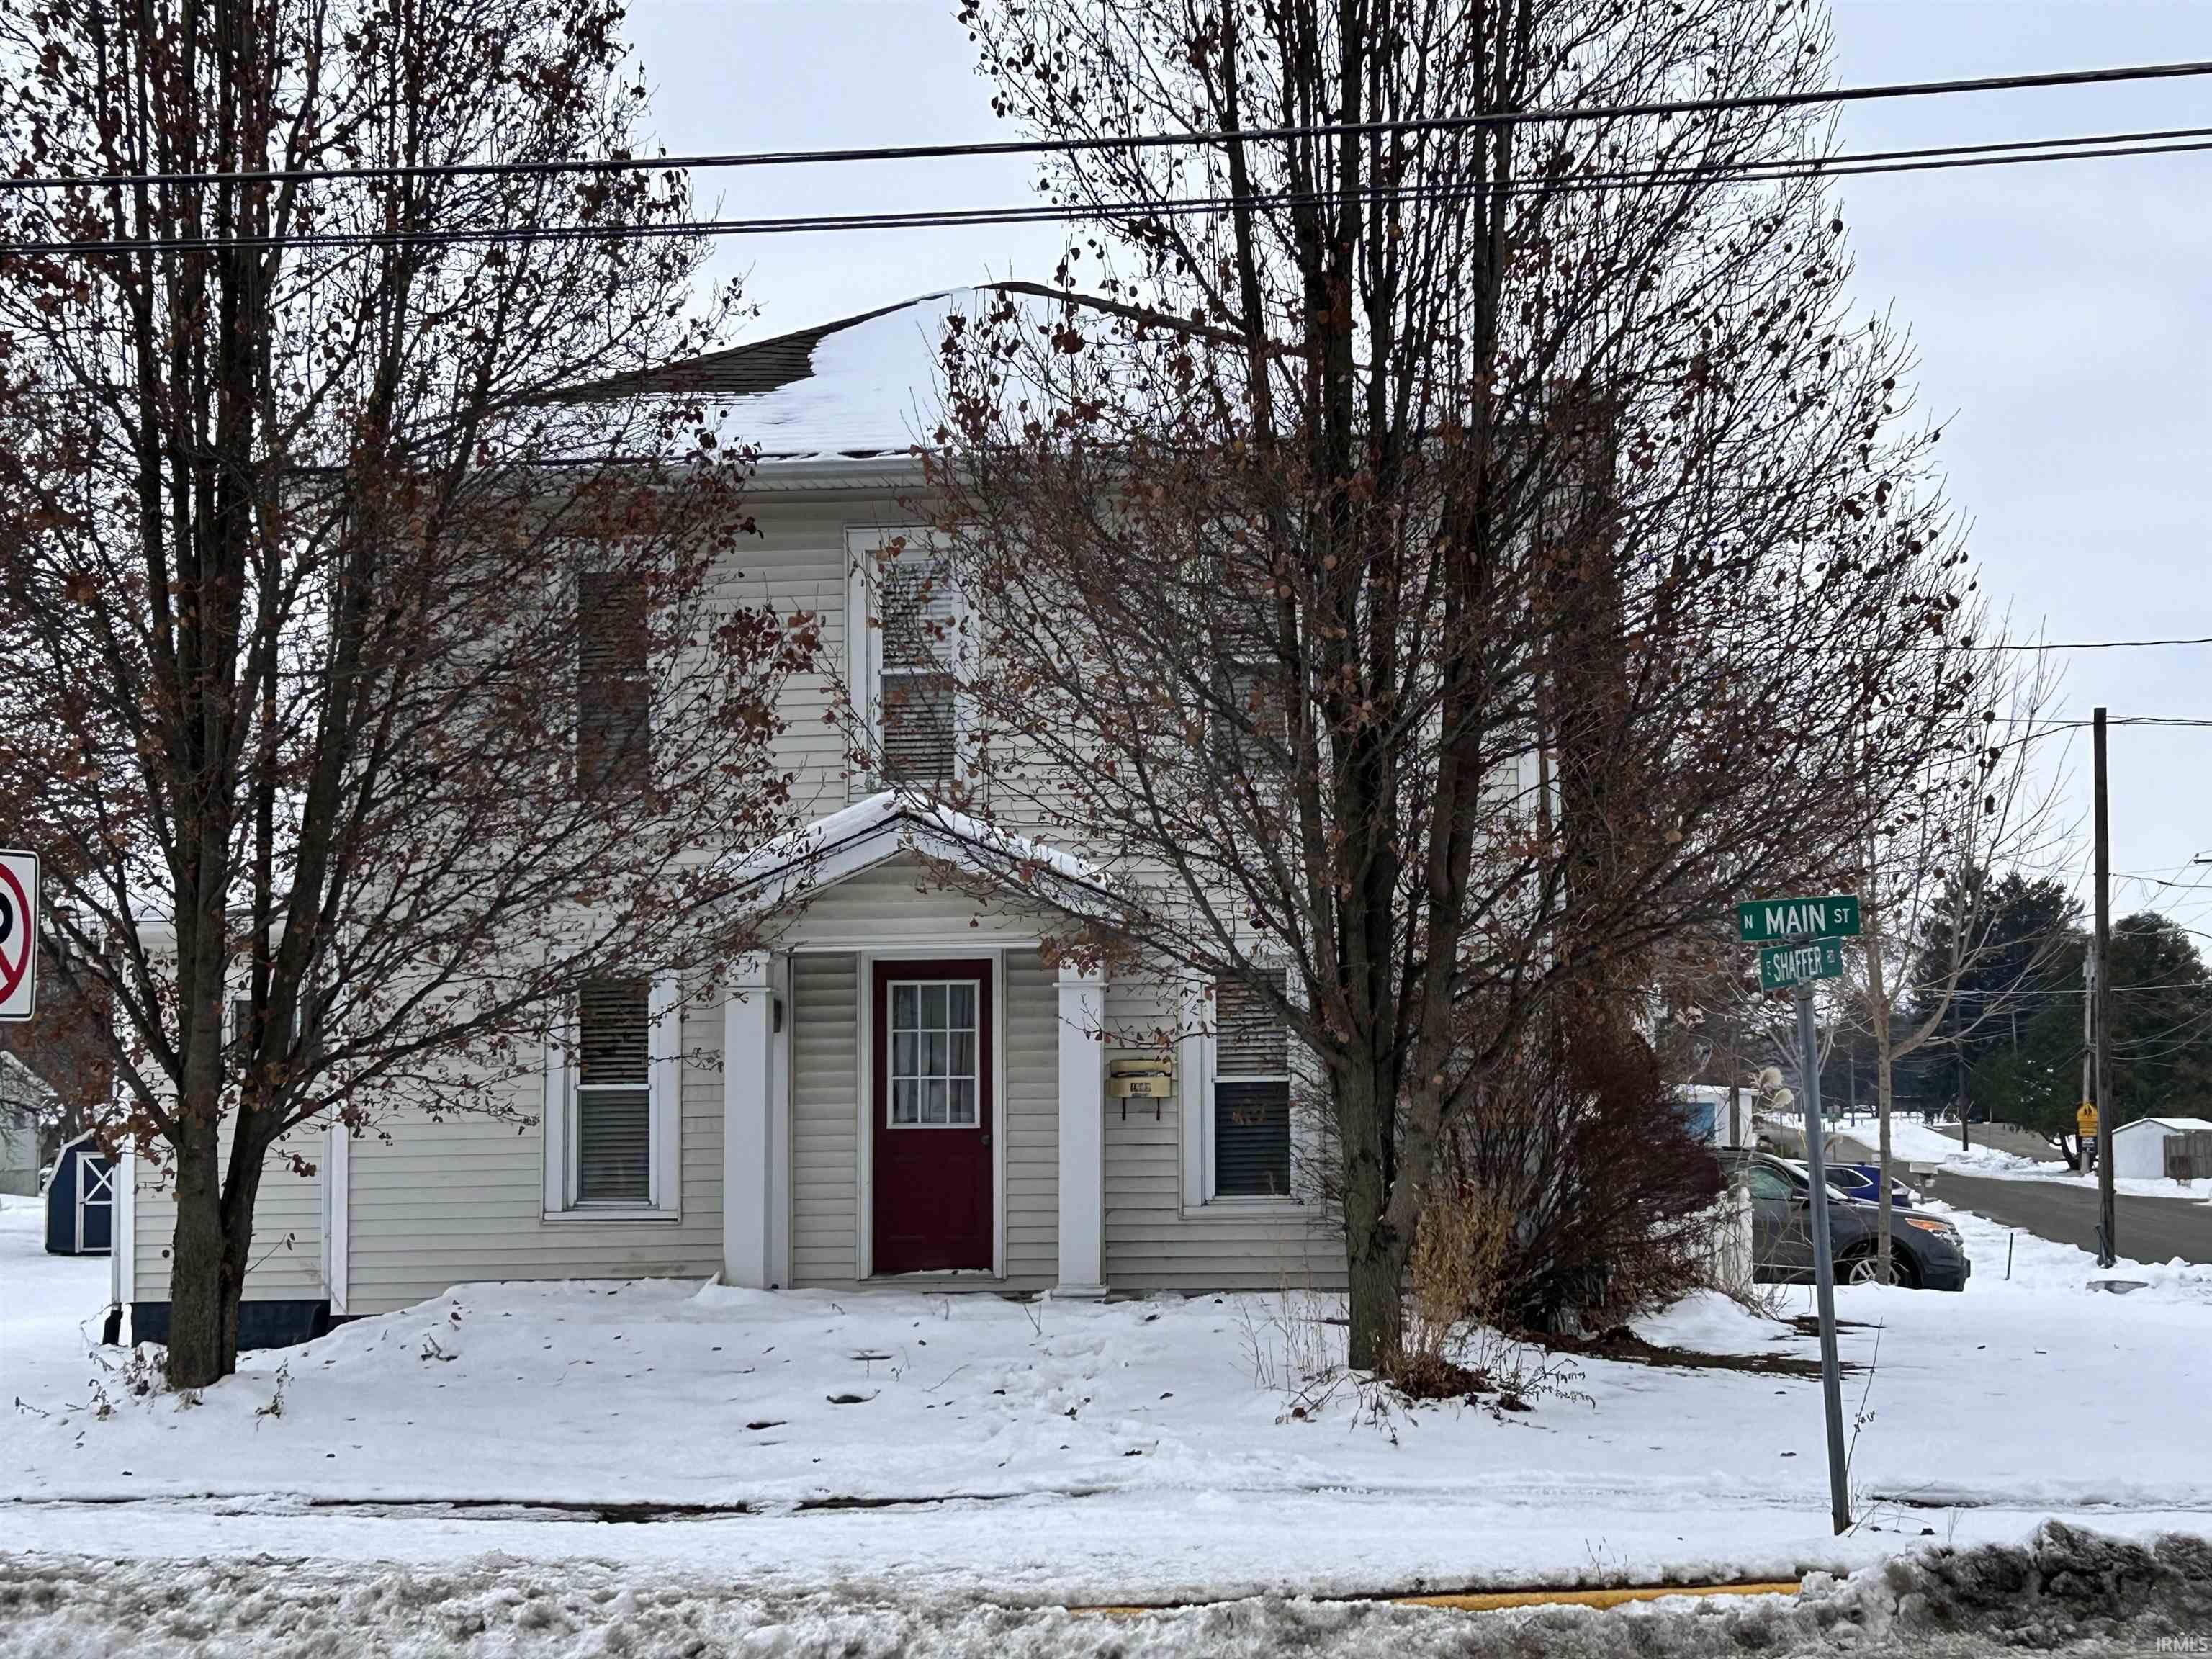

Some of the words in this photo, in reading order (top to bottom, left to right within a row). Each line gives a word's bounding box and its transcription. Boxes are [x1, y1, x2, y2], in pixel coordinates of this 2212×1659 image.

[1744, 915, 1753, 929] N
[1765, 904, 1826, 935] MAIN
[1833, 909, 1850, 923] ST
[1773, 946, 1822, 981] SHAFFER
